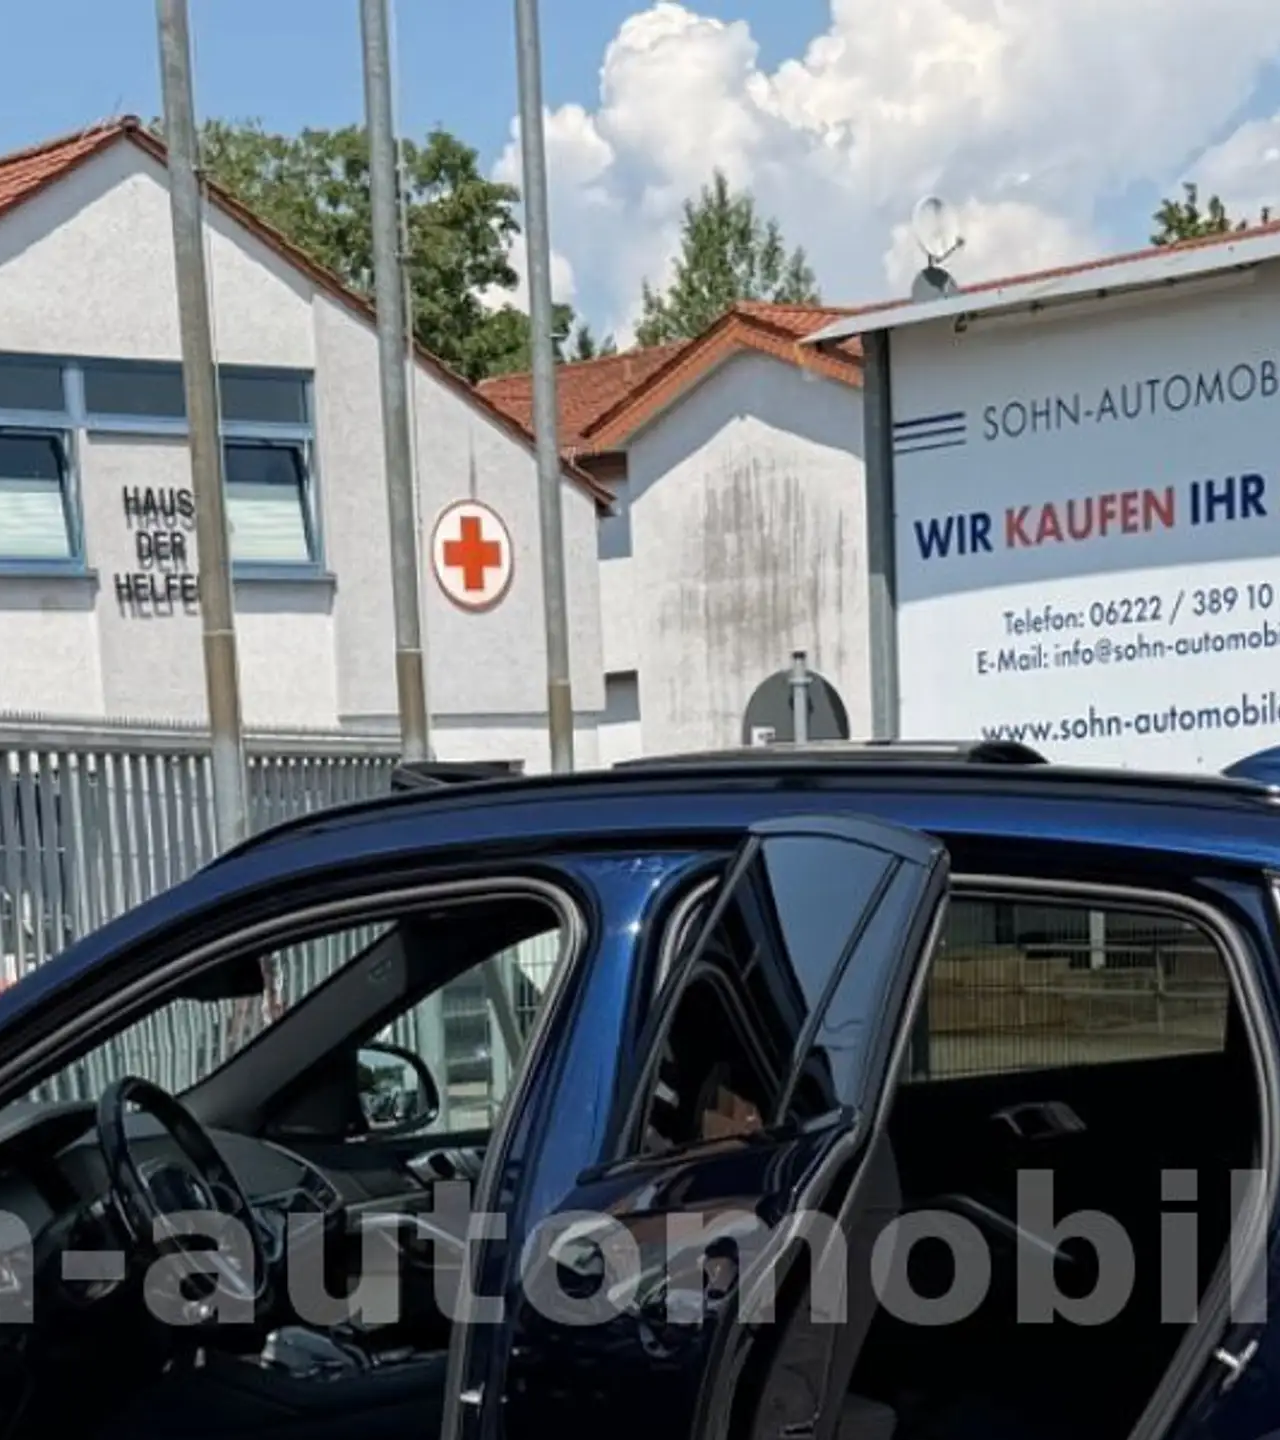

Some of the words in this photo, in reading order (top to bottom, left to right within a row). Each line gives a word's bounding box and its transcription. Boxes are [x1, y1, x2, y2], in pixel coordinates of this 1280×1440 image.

[122, 485, 195, 517] HAUS
[914, 511, 994, 561] WIR
[1004, 485, 1175, 549] KAUFEN
[1190, 473, 1268, 526] IHR
[136, 531, 187, 561] DER
[114, 573, 200, 603] HELFE
[1003, 604, 1084, 635] Telefon:
[1089, 595, 1162, 627] 06222
[1168, 589, 1186, 626] /
[1192, 586, 1239, 617] 389
[1247, 582, 1274, 611] 10
[976, 642, 1050, 675] E-Mail:
